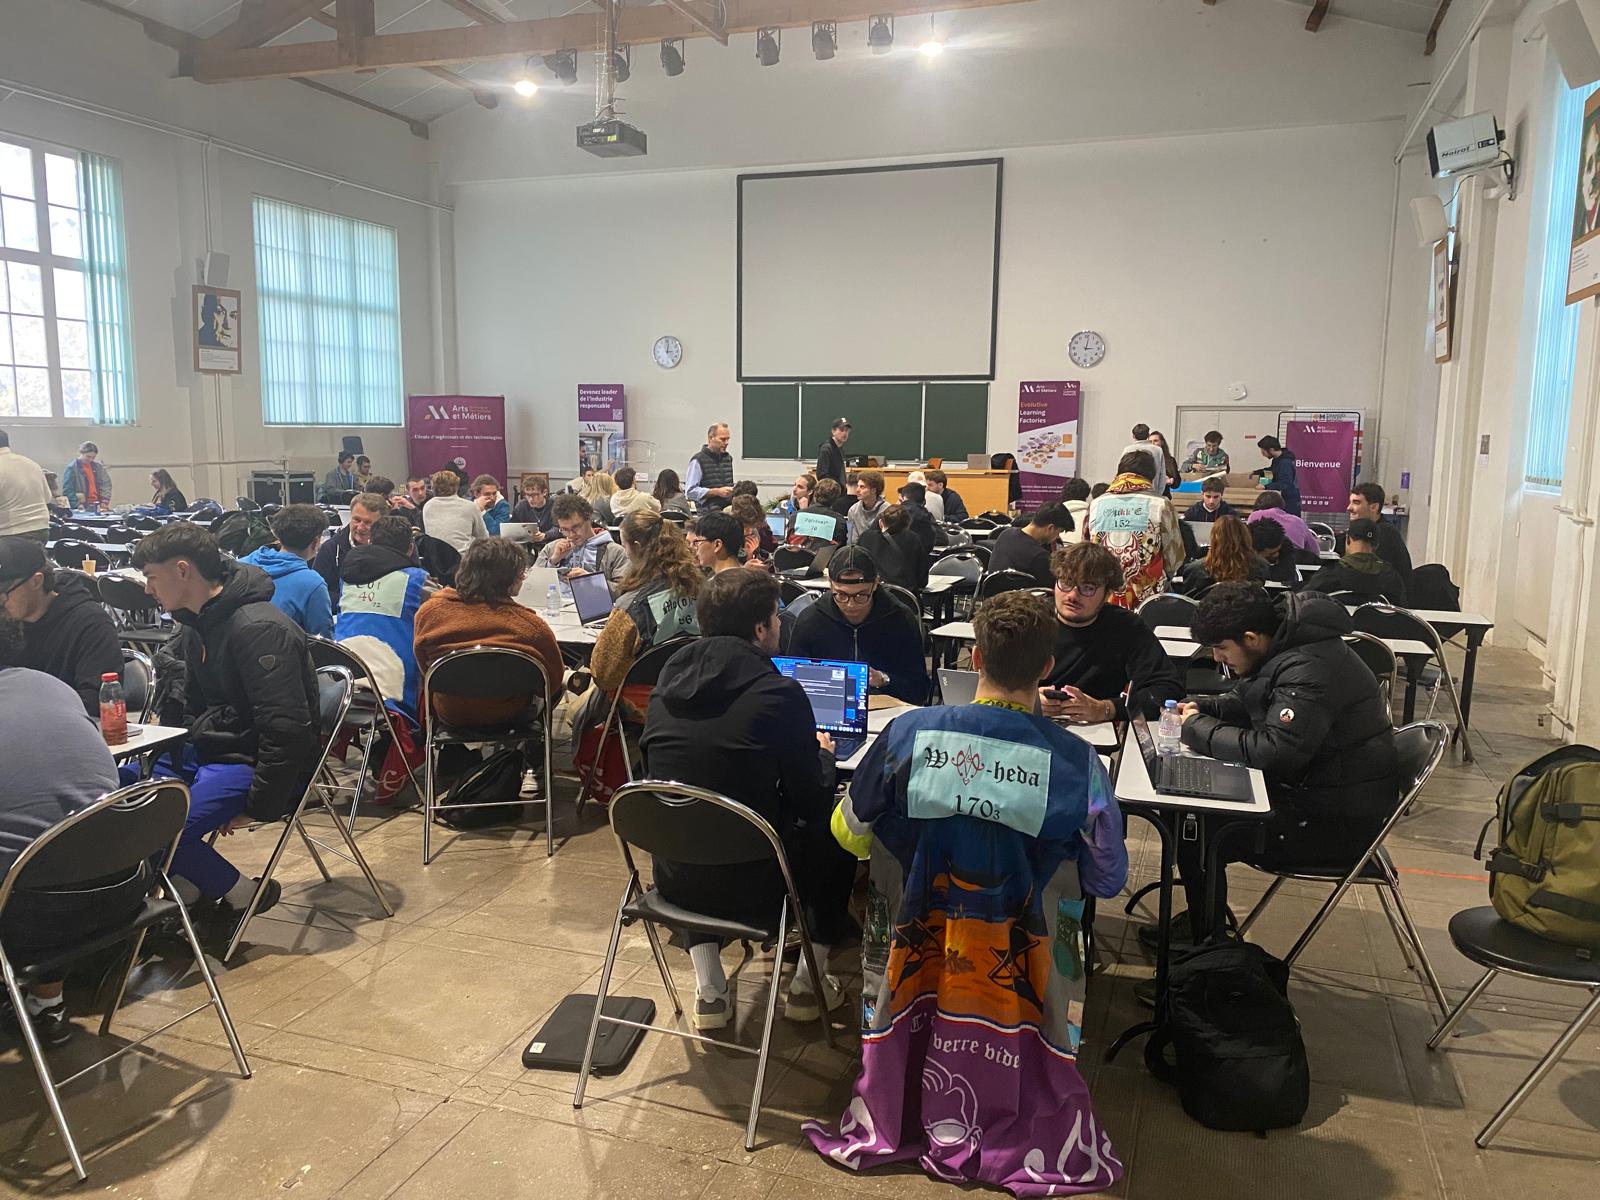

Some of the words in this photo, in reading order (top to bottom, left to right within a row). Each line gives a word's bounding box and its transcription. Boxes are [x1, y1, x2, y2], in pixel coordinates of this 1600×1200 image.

[462, 412, 492, 421] Métiers
[1295, 459, 1341, 468] Bienvenue
[1114, 520, 1131, 528] 152
